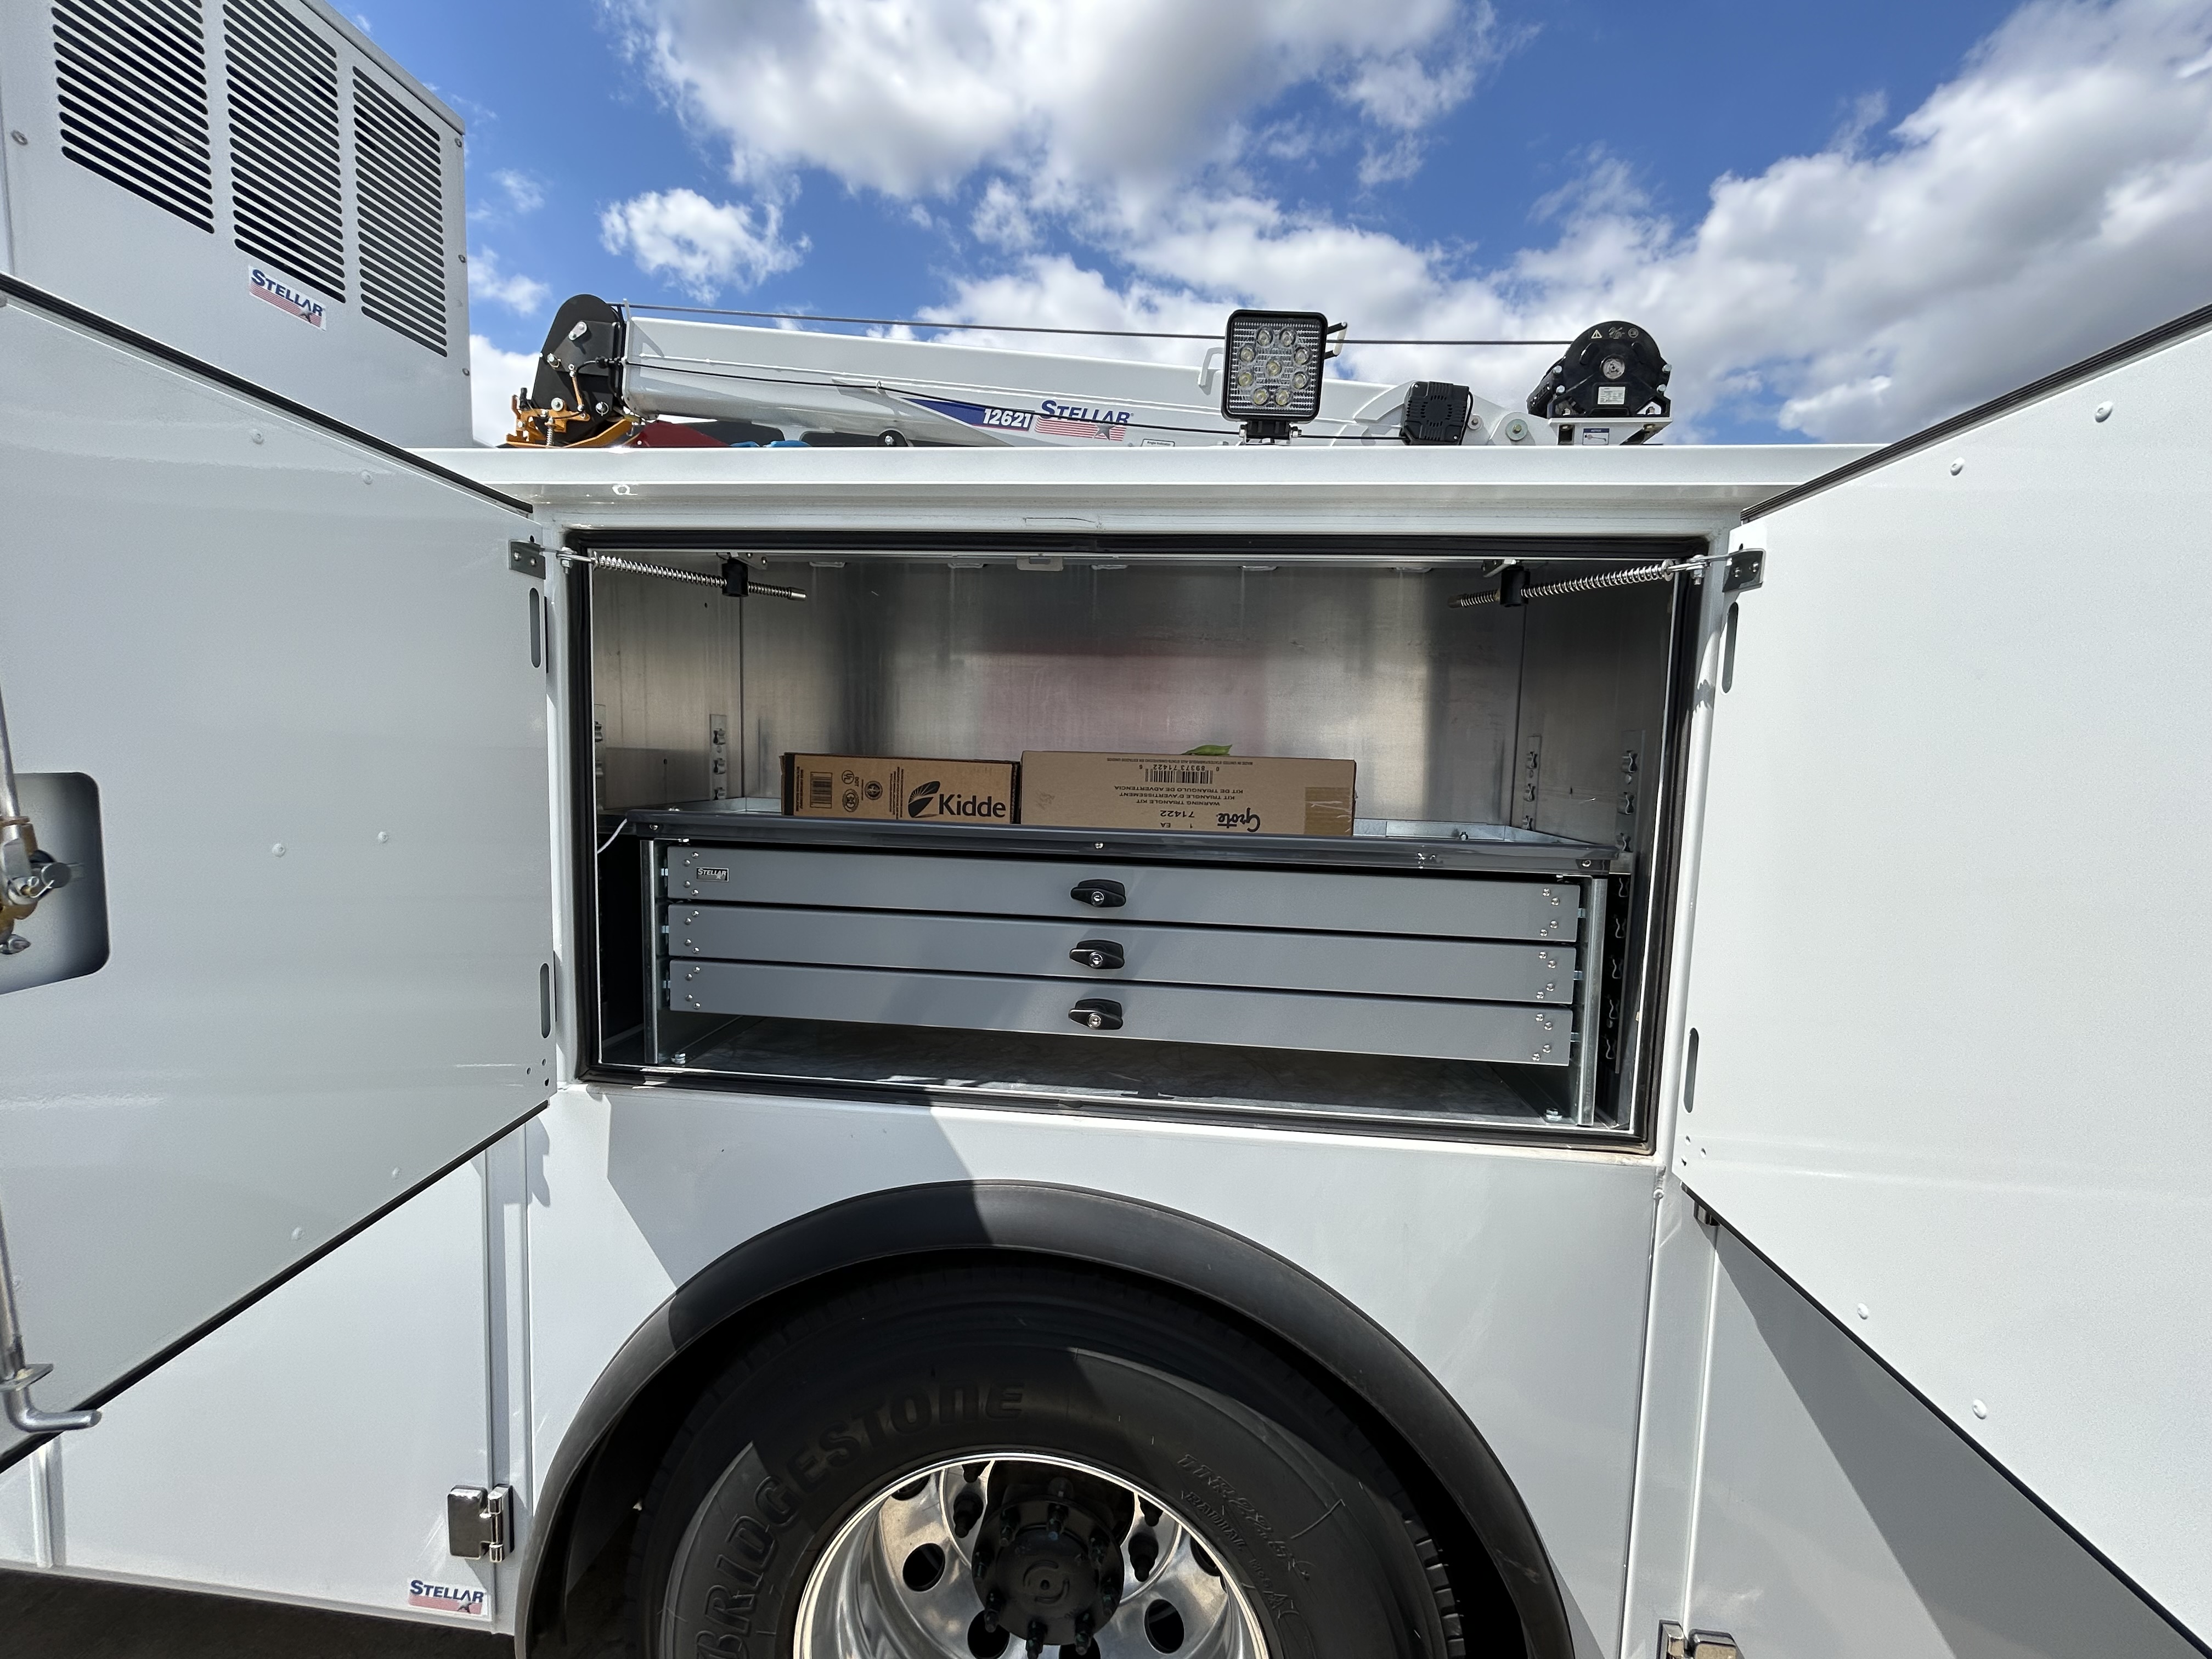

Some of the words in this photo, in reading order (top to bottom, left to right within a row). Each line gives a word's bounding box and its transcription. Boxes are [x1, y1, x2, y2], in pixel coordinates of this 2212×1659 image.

[251, 269, 323, 317] STELLAR
[983, 409, 1031, 428] 12621
[1041, 400, 1131, 425] STELLAR
[939, 794, 1006, 818] Kidde
[1217, 807, 1260, 832] Grote
[698, 868, 727, 876] STELLAR
[696, 1380, 1025, 1659] BRIDGESTONE
[410, 1579, 484, 1603] STELLAR
